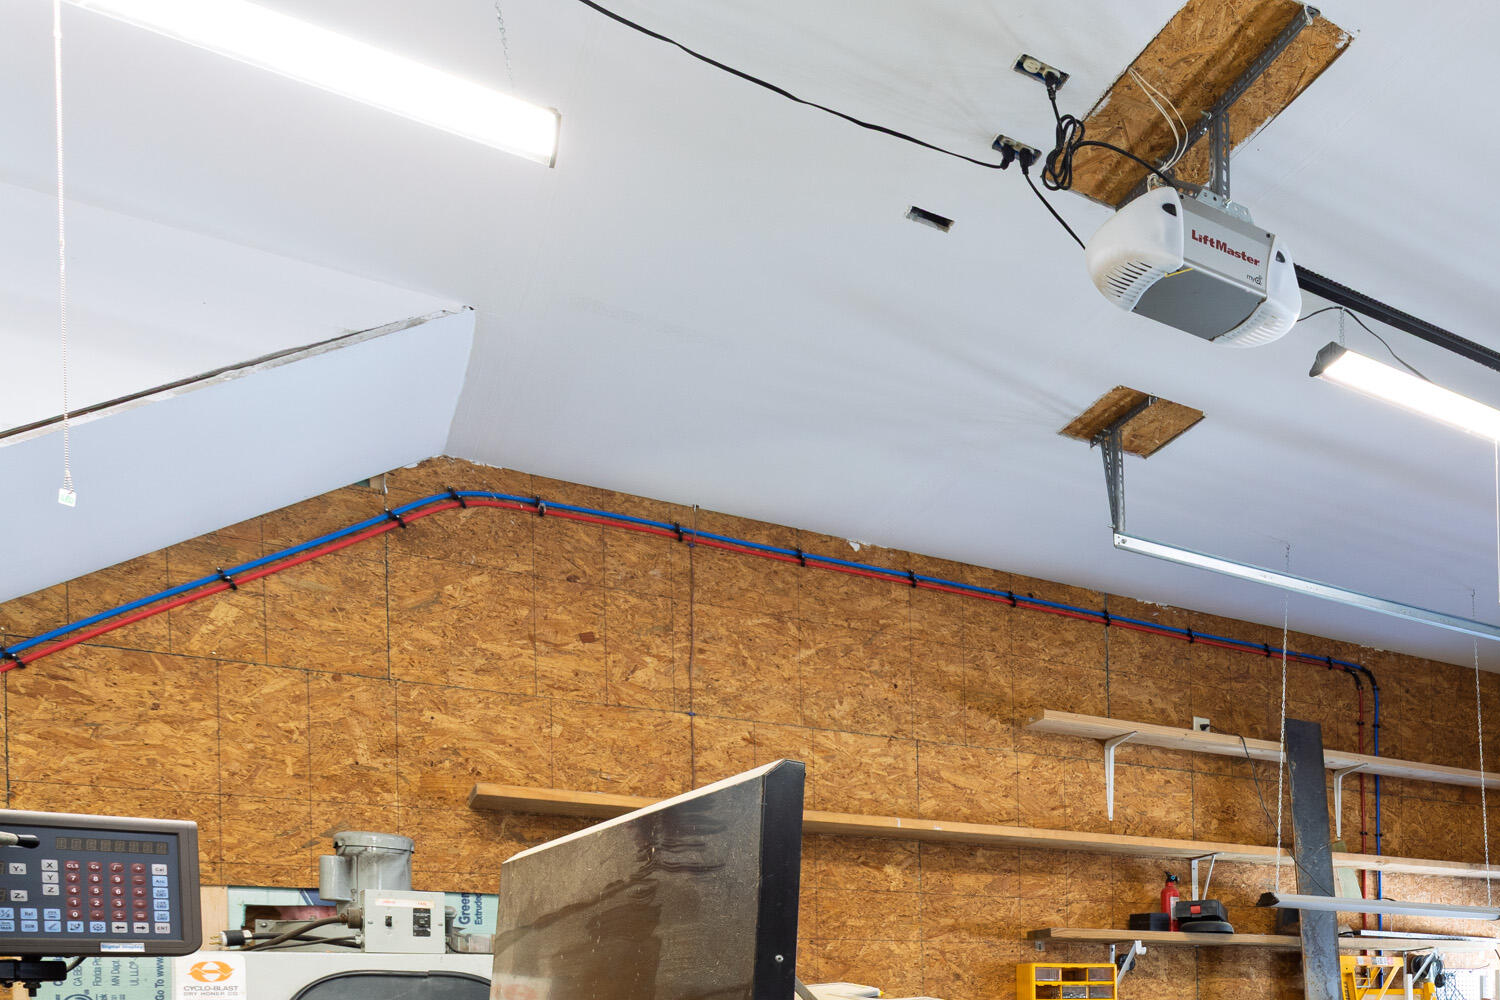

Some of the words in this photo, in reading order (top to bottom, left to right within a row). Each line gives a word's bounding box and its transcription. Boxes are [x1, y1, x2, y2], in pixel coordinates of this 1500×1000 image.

[1191, 229, 1260, 266] LiftMaster
[155, 979, 164, 988] To
[155, 990, 165, 1000] Go
